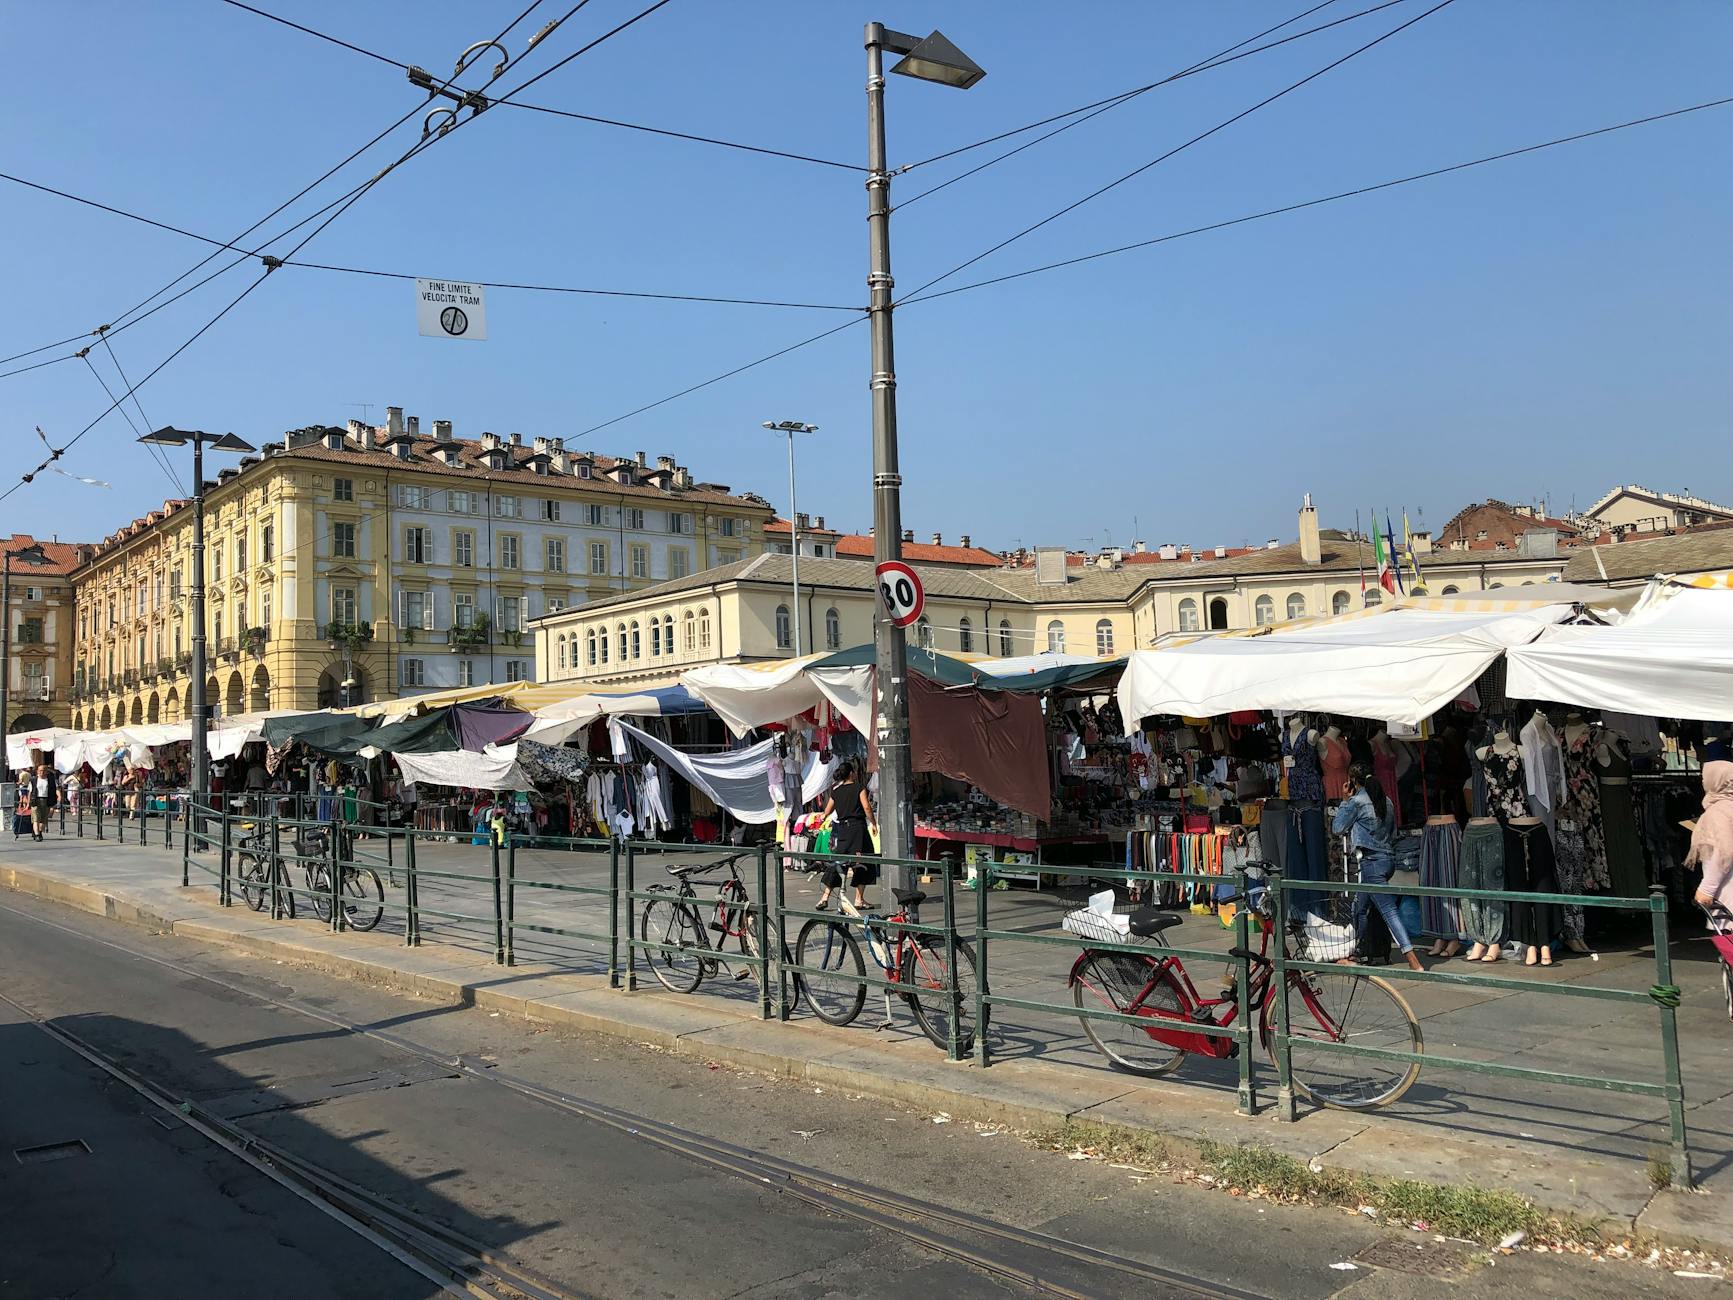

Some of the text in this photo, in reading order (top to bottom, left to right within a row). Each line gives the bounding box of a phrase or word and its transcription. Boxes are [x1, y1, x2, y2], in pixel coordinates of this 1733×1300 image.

[429, 282, 472, 294] FINE LIMITE
[460, 295, 480, 305] TRAM
[881, 578, 914, 611] 30
